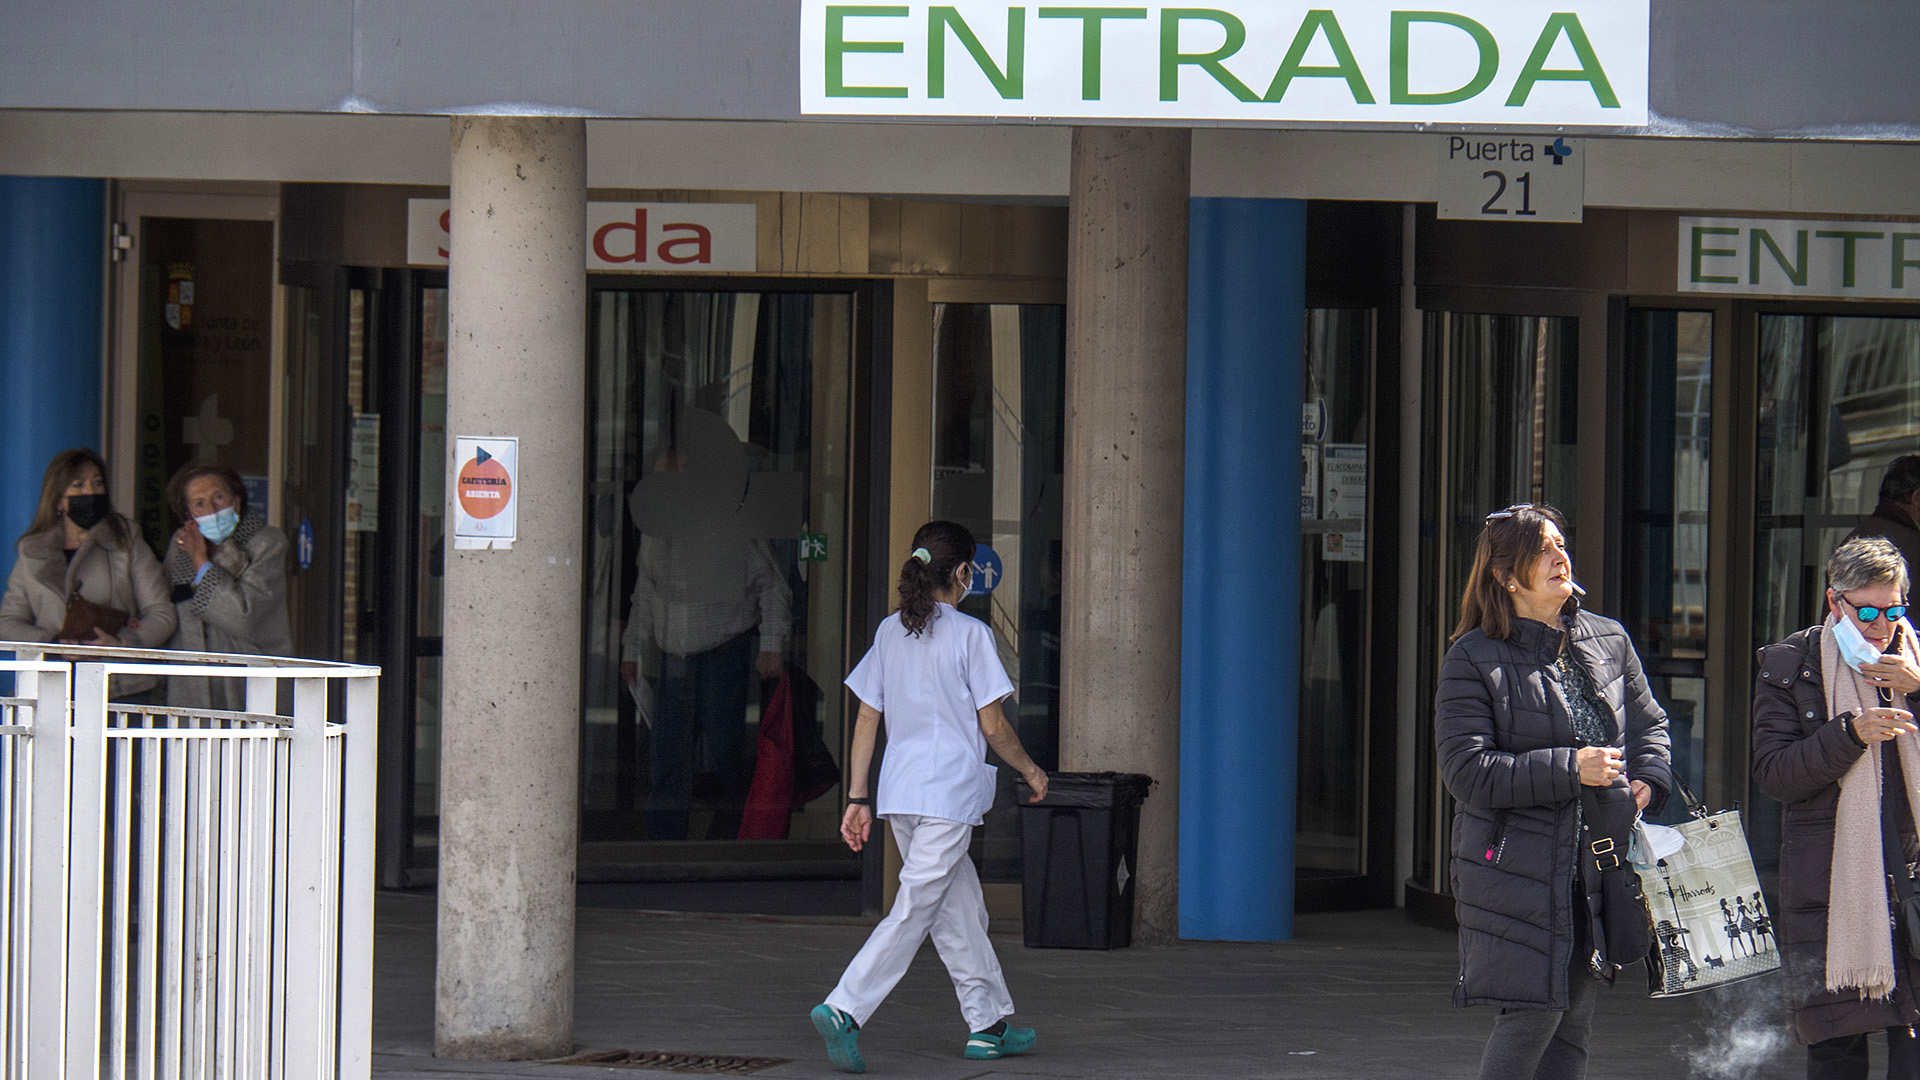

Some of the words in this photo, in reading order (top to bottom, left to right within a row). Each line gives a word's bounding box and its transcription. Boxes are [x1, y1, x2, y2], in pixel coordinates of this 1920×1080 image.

[824, 5, 1622, 108] ENTRADA
[1450, 136, 1534, 162] Puerta
[1481, 169, 1537, 216] 21
[462, 477, 506, 486] CAFETERÍA
[465, 490, 501, 499] ABIERTA
[1679, 881, 1715, 902] Harrods
